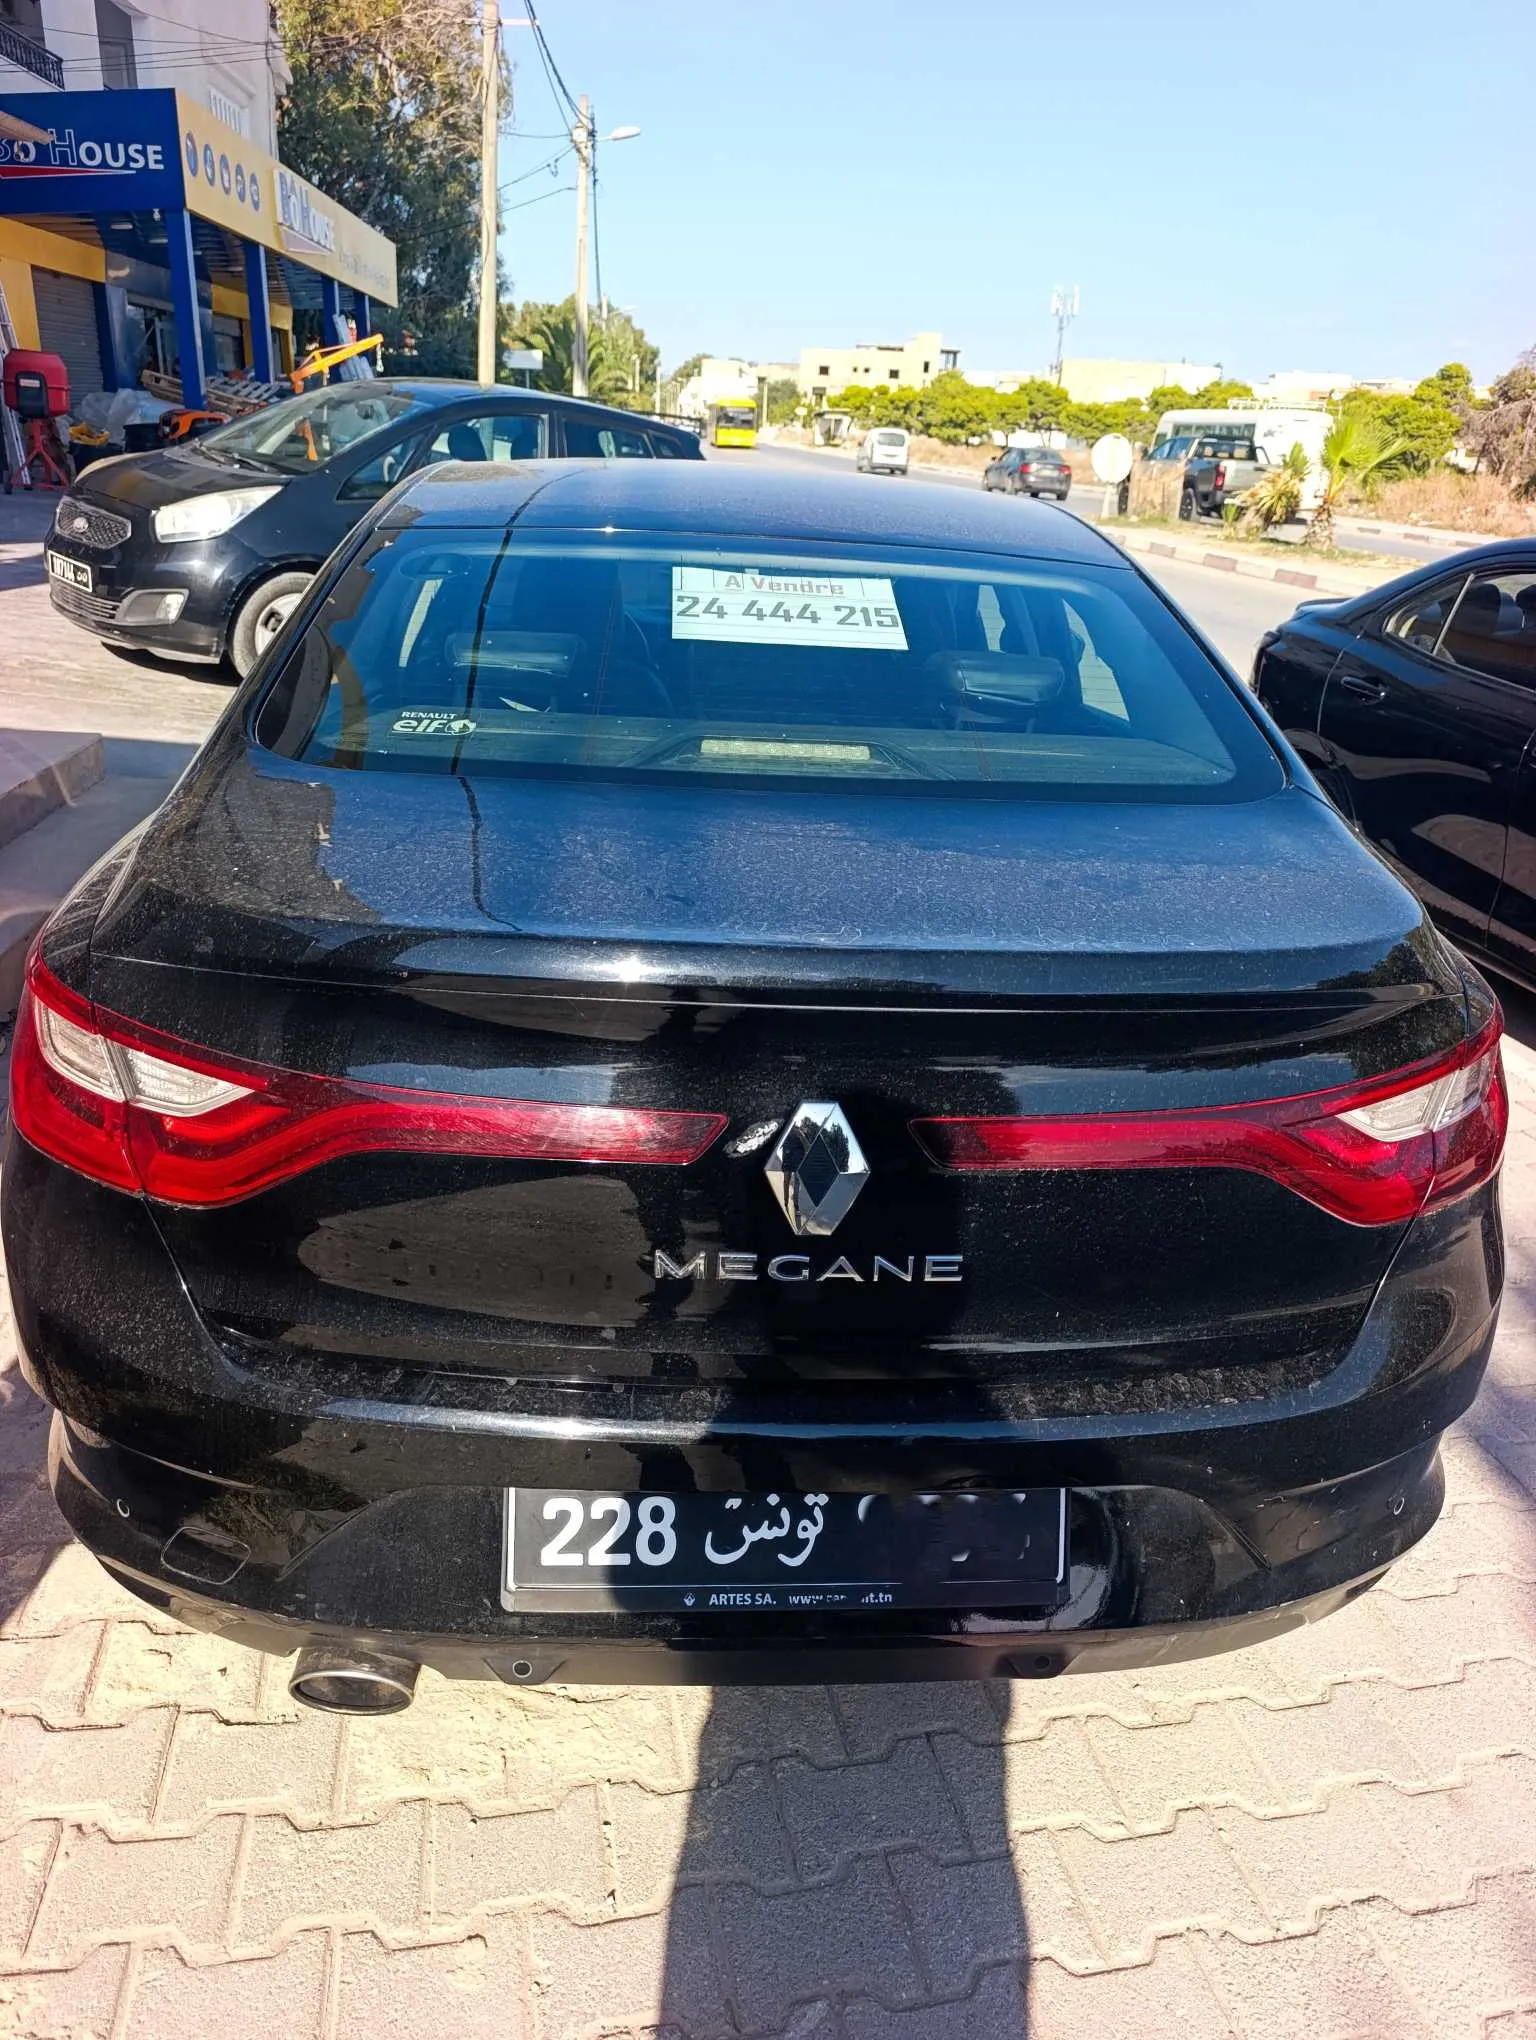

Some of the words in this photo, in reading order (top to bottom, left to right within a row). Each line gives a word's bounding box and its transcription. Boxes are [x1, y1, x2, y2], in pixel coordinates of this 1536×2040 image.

[724, 574, 742, 589] A
[750, 576, 845, 596] Vendre
[676, 595, 729, 619] 24
[742, 599, 822, 624] 444
[834, 605, 900, 629] 215
[392, 719, 448, 733] elf
[401, 711, 457, 720] RENAULT
[654, 1249, 964, 1282] MEGANE
[540, 1496, 677, 1567] 228
[704, 1493, 829, 1567] تونس
[709, 1593, 752, 1605] ARTES
[754, 1593, 777, 1605] SA.
